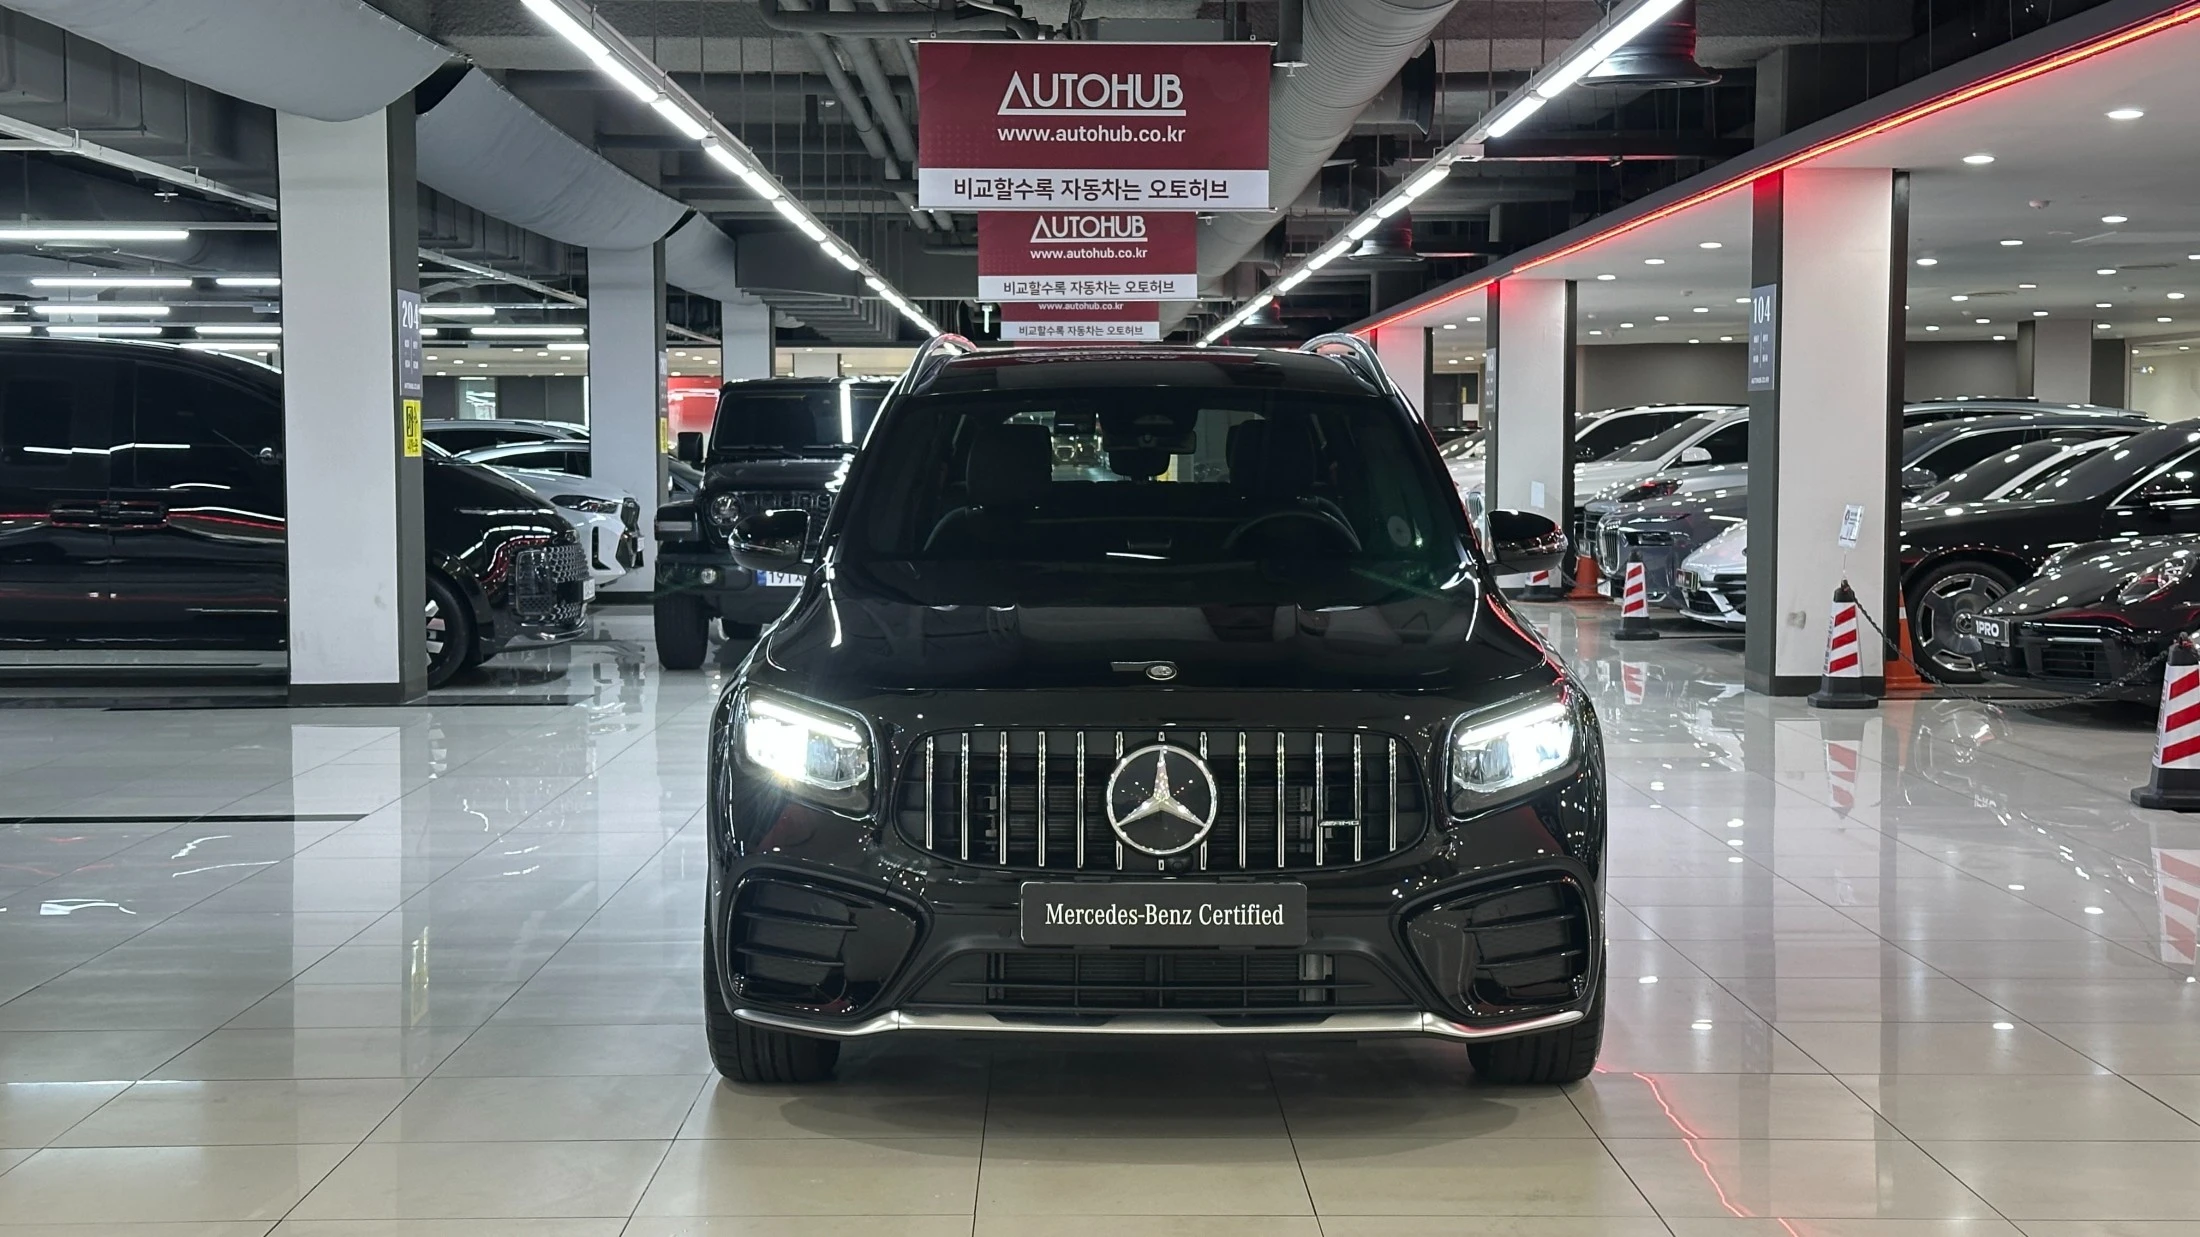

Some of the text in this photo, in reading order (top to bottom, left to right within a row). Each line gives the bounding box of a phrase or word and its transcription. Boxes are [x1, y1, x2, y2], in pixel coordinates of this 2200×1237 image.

[998, 71, 1187, 117] AUTOHUB
[998, 125, 1186, 142] www.autohub.co.kr
[954, 177, 1230, 201] 비교할수록 자동차는 오토허브
[1030, 215, 1148, 243] AUTOHUB
[1030, 247, 1148, 259] www.autohub.co.kr
[1003, 280, 1175, 295] 비교할수록 자동차는 오토허브
[402, 300, 419, 330] 204
[1038, 302, 1124, 310] www.autohub.co.kr
[1753, 295, 1771, 324] 104
[1018, 325, 1143, 336] 비교할수록 자동차는 오토허브
[1045, 904, 1285, 926] Mercedes-Benz Certified
